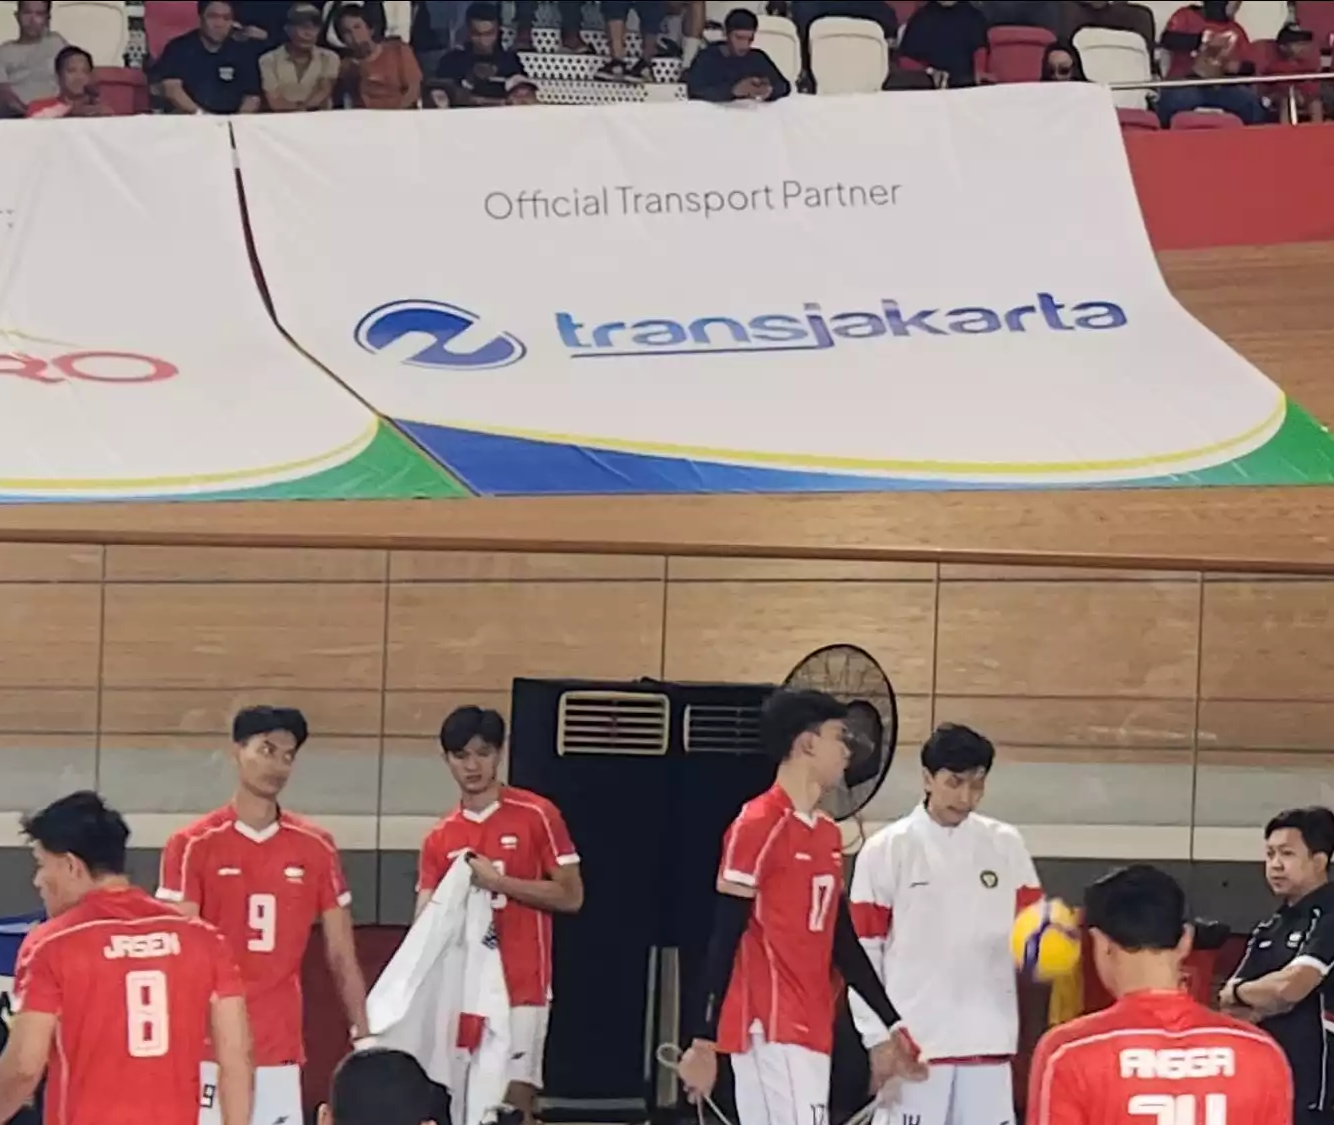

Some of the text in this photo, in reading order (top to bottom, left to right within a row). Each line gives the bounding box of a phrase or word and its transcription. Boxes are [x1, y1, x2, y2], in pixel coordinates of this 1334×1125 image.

[484, 178, 903, 222] Official Transport Partner
[554, 291, 1130, 349] transjakarta
[247, 893, 277, 953] 9
[809, 873, 835, 932] 17
[126, 969, 169, 1057] 8
[1118, 1046, 1235, 1080] ANGGA
